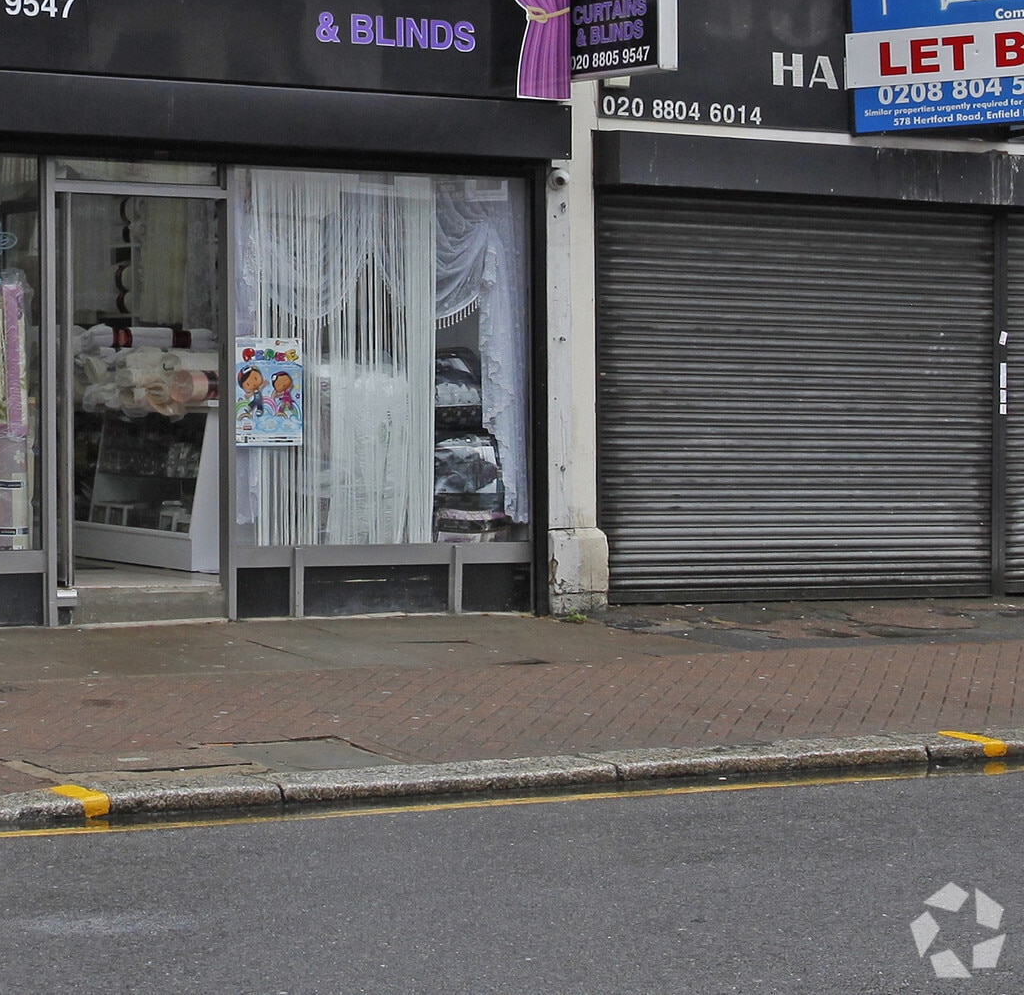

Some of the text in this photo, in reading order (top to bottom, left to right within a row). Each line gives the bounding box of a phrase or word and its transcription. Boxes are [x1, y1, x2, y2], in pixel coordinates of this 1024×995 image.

[315, 11, 477, 53] & BLINDS
[576, 19, 644, 47] & BLINDS
[592, 50, 620, 67] 8805
[622, 45, 651, 64] 9547
[879, 31, 1024, 76] LET B
[877, 81, 943, 105] 0208
[952, 77, 1003, 100] 804
[602, 95, 763, 125] 020 8804 6014
[864, 98, 1024, 117] Similar properties urgently required for
[893, 117, 911, 126] 578
[913, 113, 954, 125] Hertford
[956, 111, 984, 122] Road,
[986, 108, 1020, 120] Enfield
